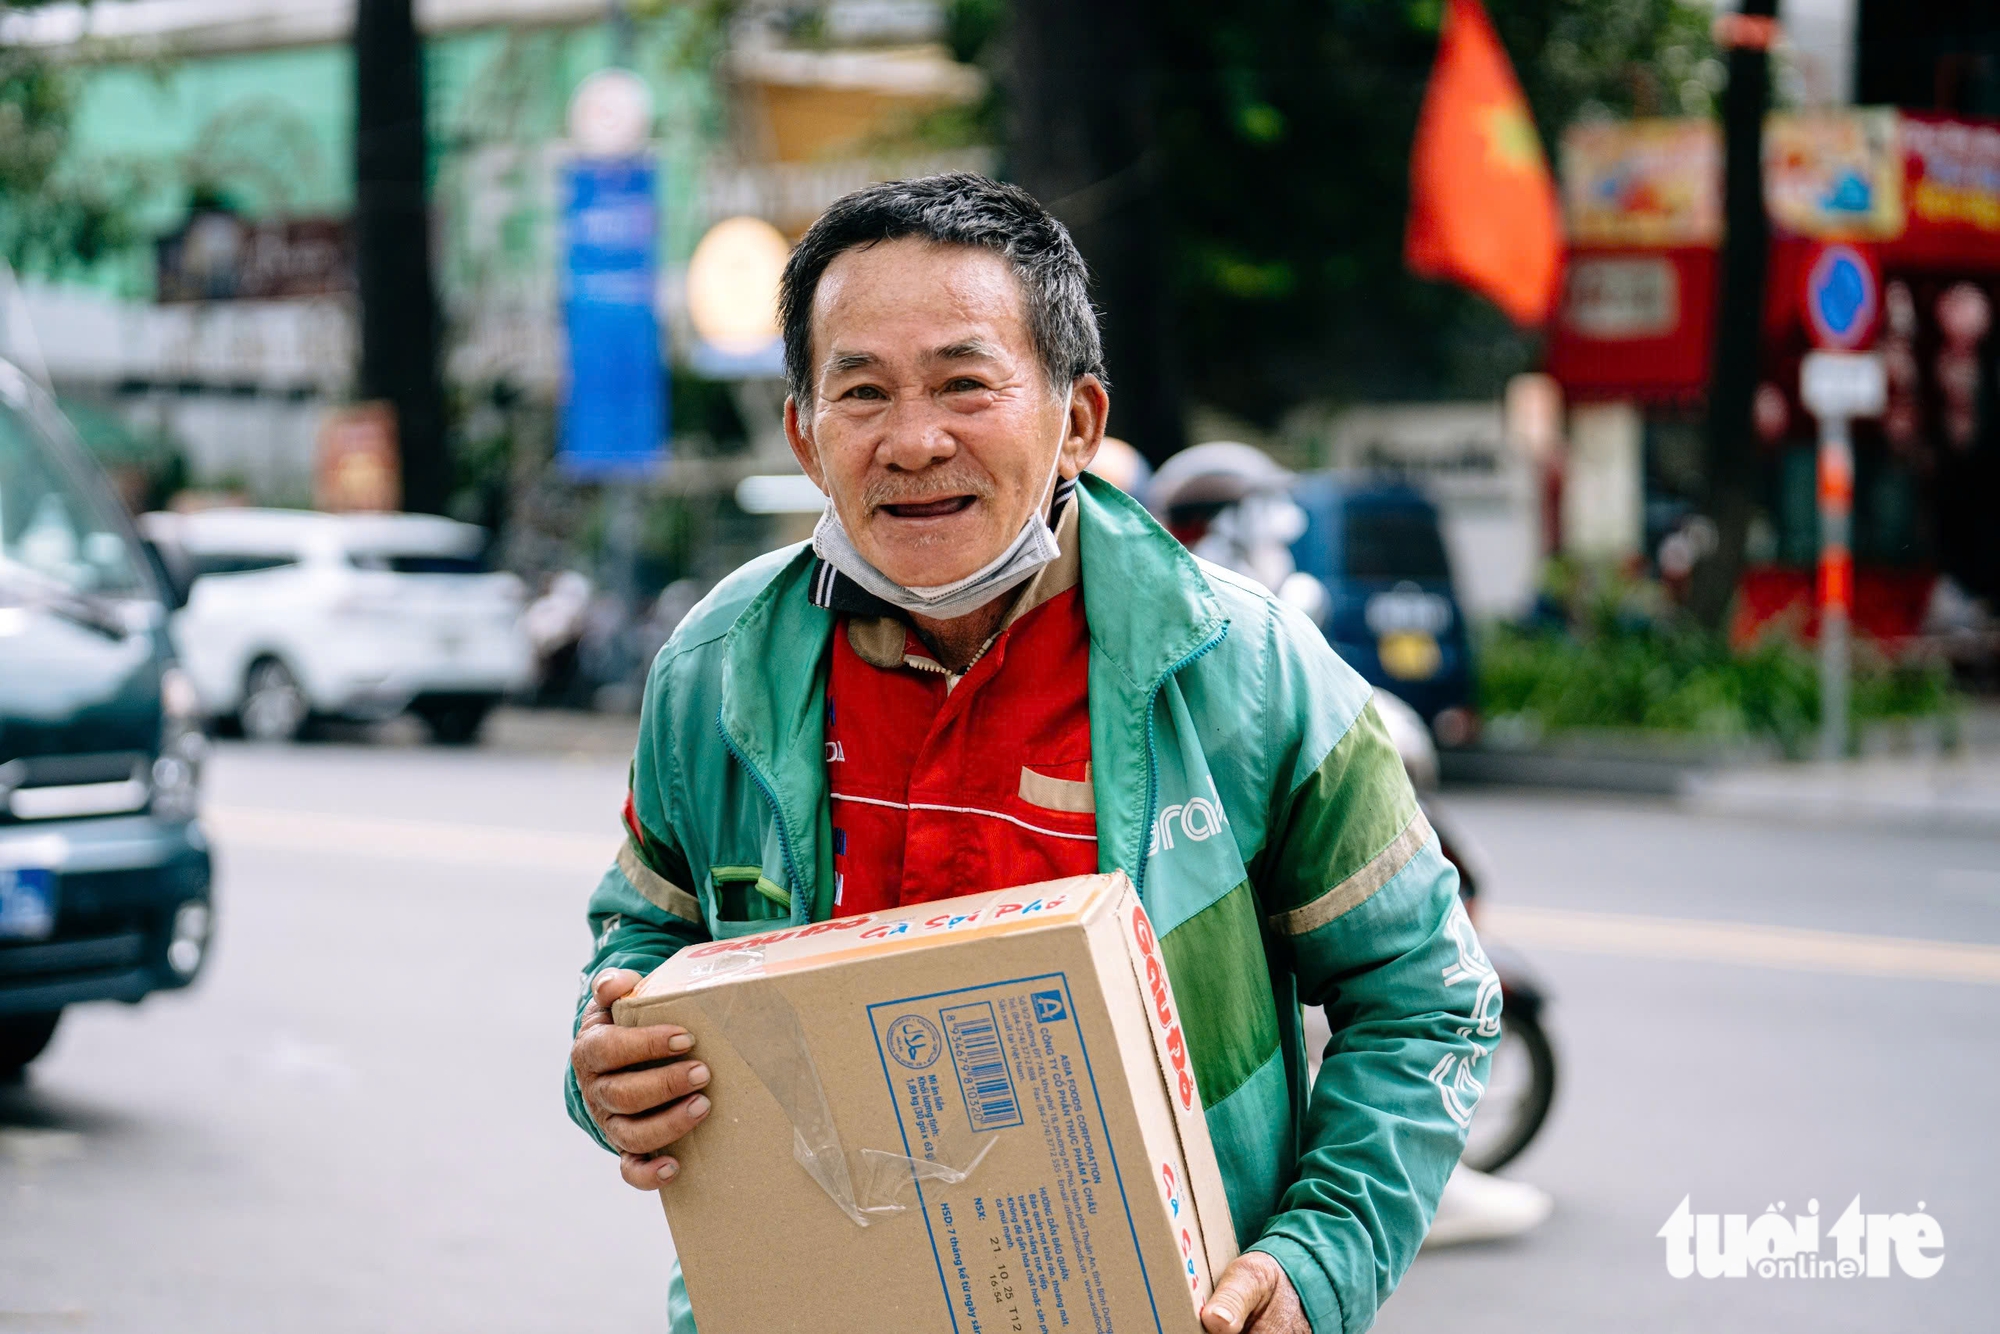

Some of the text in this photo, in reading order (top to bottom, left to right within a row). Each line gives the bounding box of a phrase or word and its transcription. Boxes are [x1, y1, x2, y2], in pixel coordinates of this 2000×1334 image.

[906, 1079, 917, 1094] 1,89
[917, 1076, 929, 1093] Khối
[910, 1095, 919, 1106] kg
[913, 1107, 925, 1119] (30
[1040, 1027, 1055, 1055] CÔNG
[1049, 1058, 1058, 1070] TY
[1083, 1187, 1097, 1214] CHÂU
[1060, 1055, 1101, 1183] ASIA FOODS CORPORATION
[924, 1141, 933, 1151] 63
[1028, 1193, 1038, 1209] Bảo
[1057, 1179, 1069, 1202] Email:
[940, 1203, 952, 1226] HSD:
[974, 1197, 986, 1220] NSX:
[1006, 1197, 1018, 1222] Không
[1062, 1158, 1069, 1168] An
[1088, 1256, 1096, 1269] An,
[949, 1237, 962, 1266] tháng
[957, 1267, 969, 1279] kể
[961, 1281, 970, 1291] từ
[989, 1274, 1002, 1303] 16:54
[964, 1293, 976, 1317] ngày
[1009, 1306, 1021, 1331] T12
